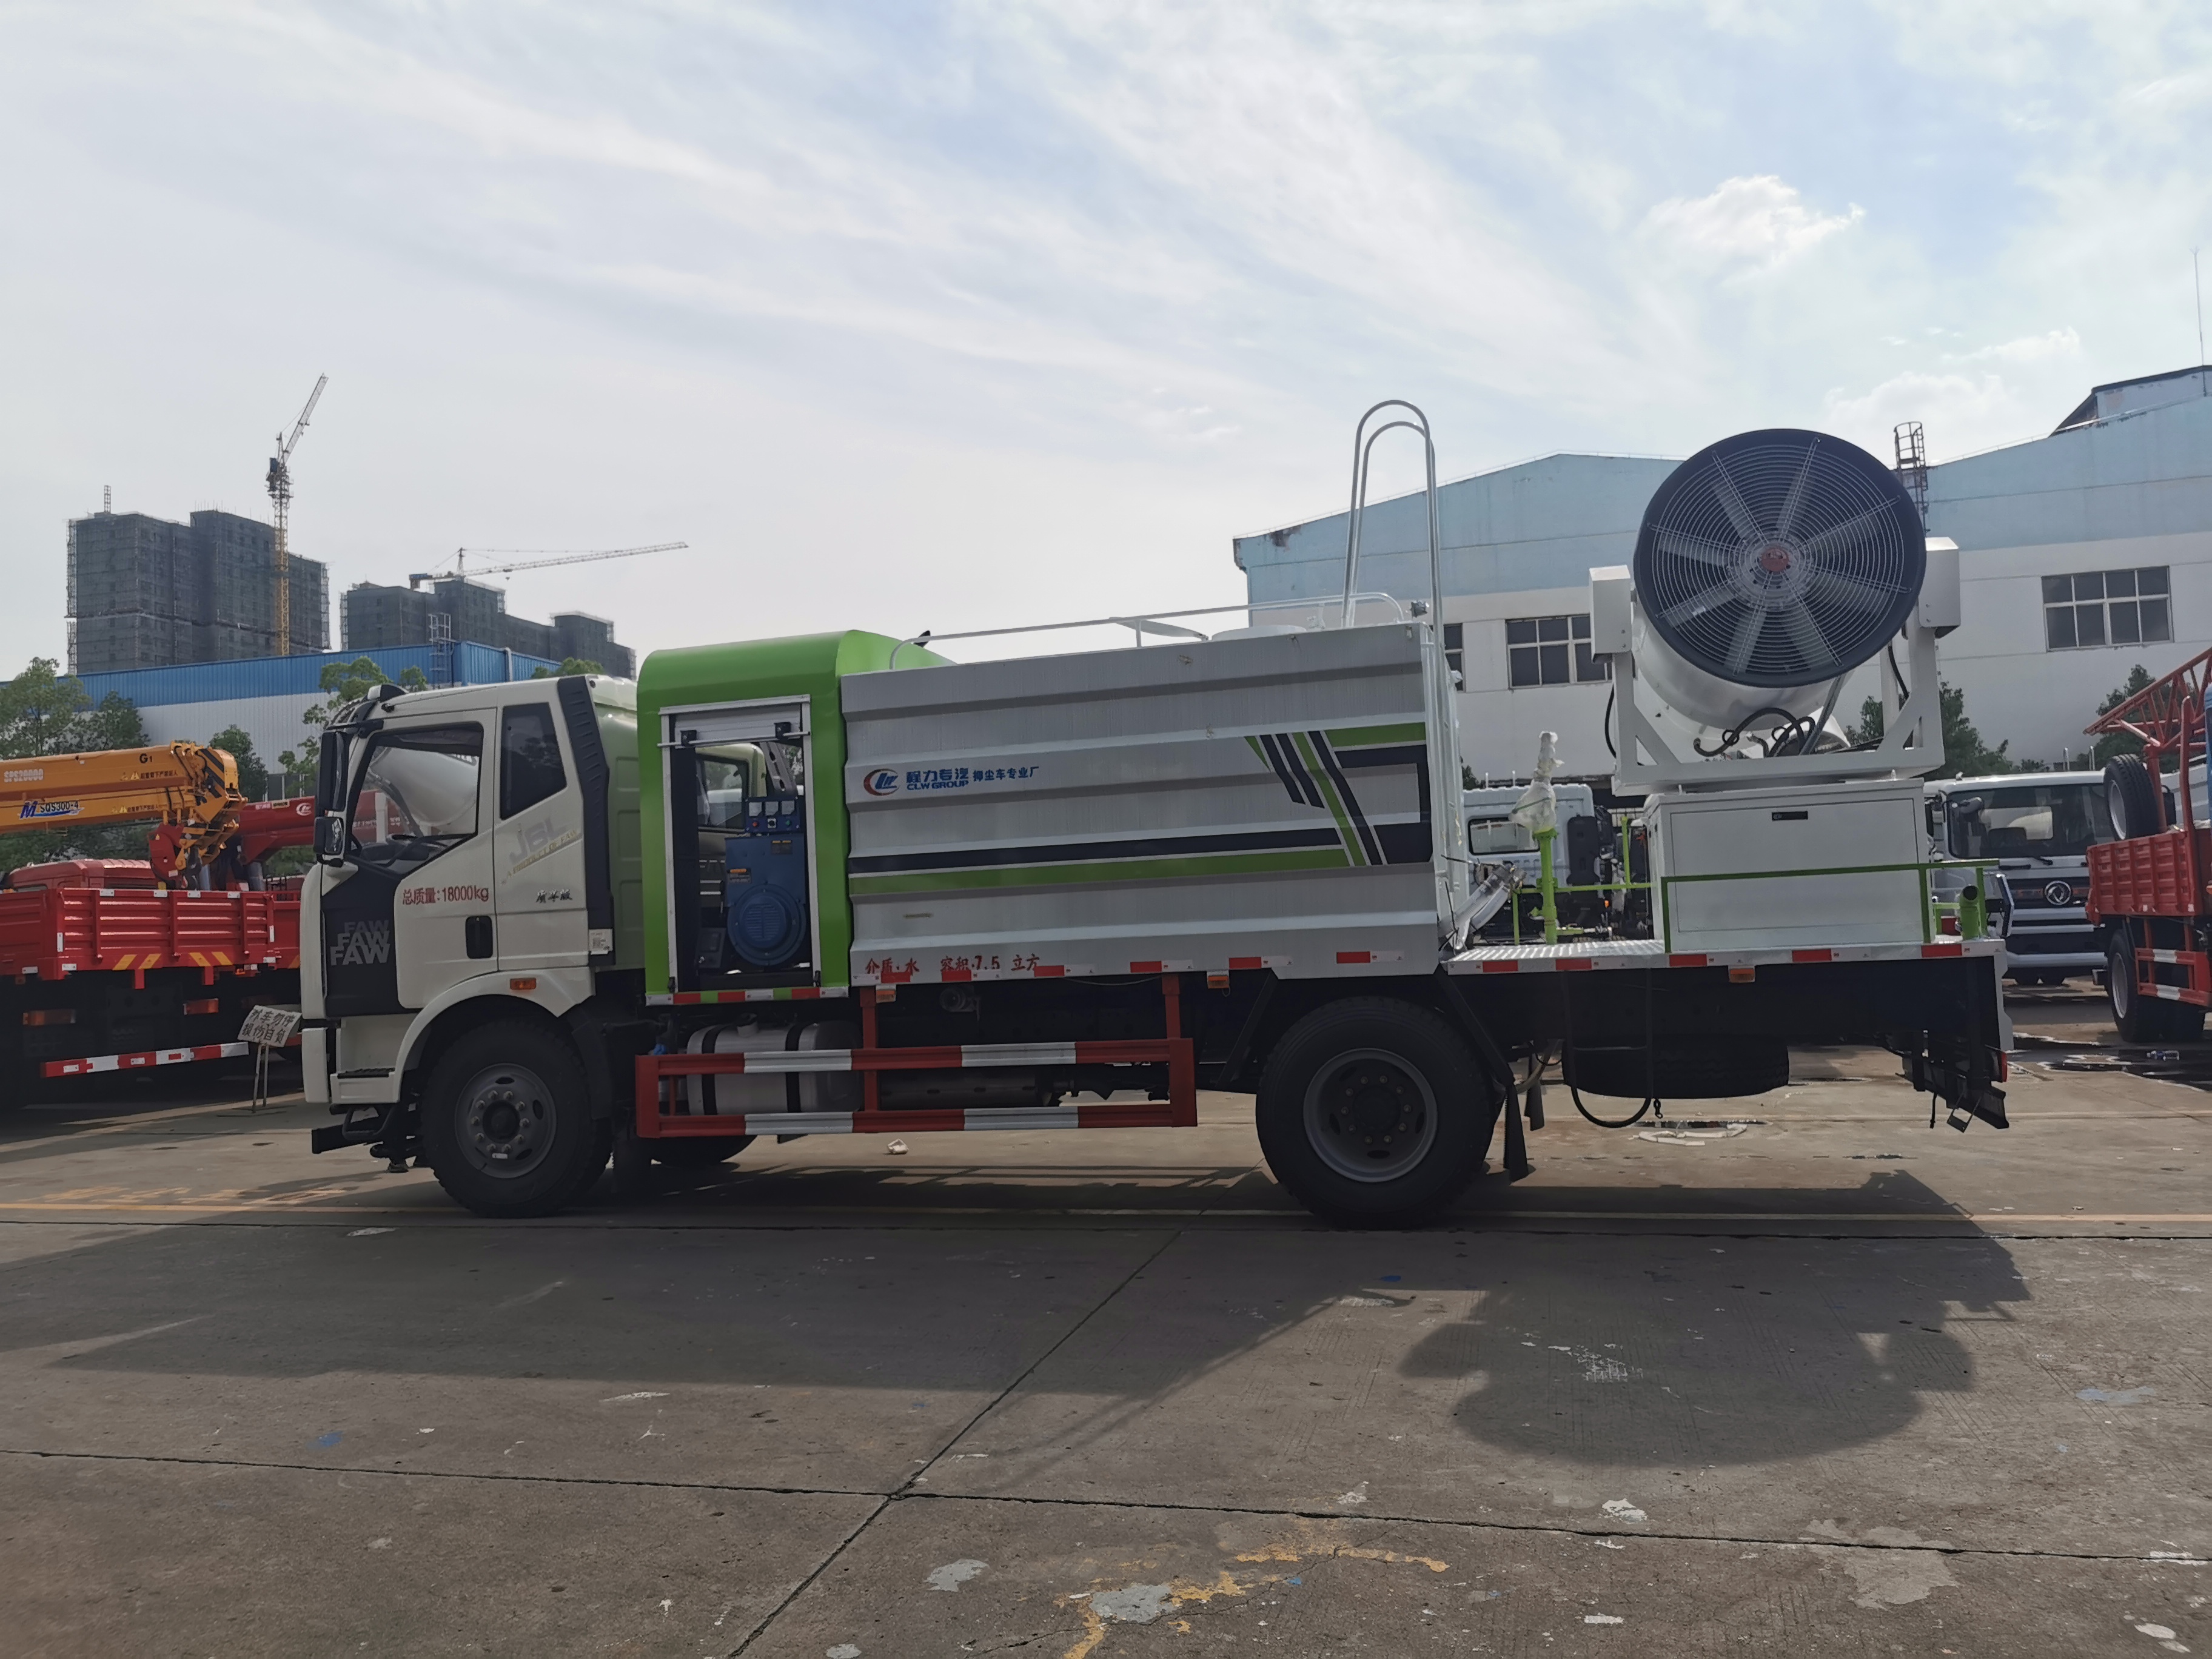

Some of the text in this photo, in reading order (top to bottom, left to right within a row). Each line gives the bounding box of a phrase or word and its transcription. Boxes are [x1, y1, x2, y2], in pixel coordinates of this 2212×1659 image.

[906, 780, 969, 791] CLW GROUP
[39, 800, 79, 813] SQS300-4
[344, 920, 389, 934] FAW
[337, 930, 390, 948] FAW
[330, 943, 390, 966] FAW
[1010, 953, 1041, 971] 立方
